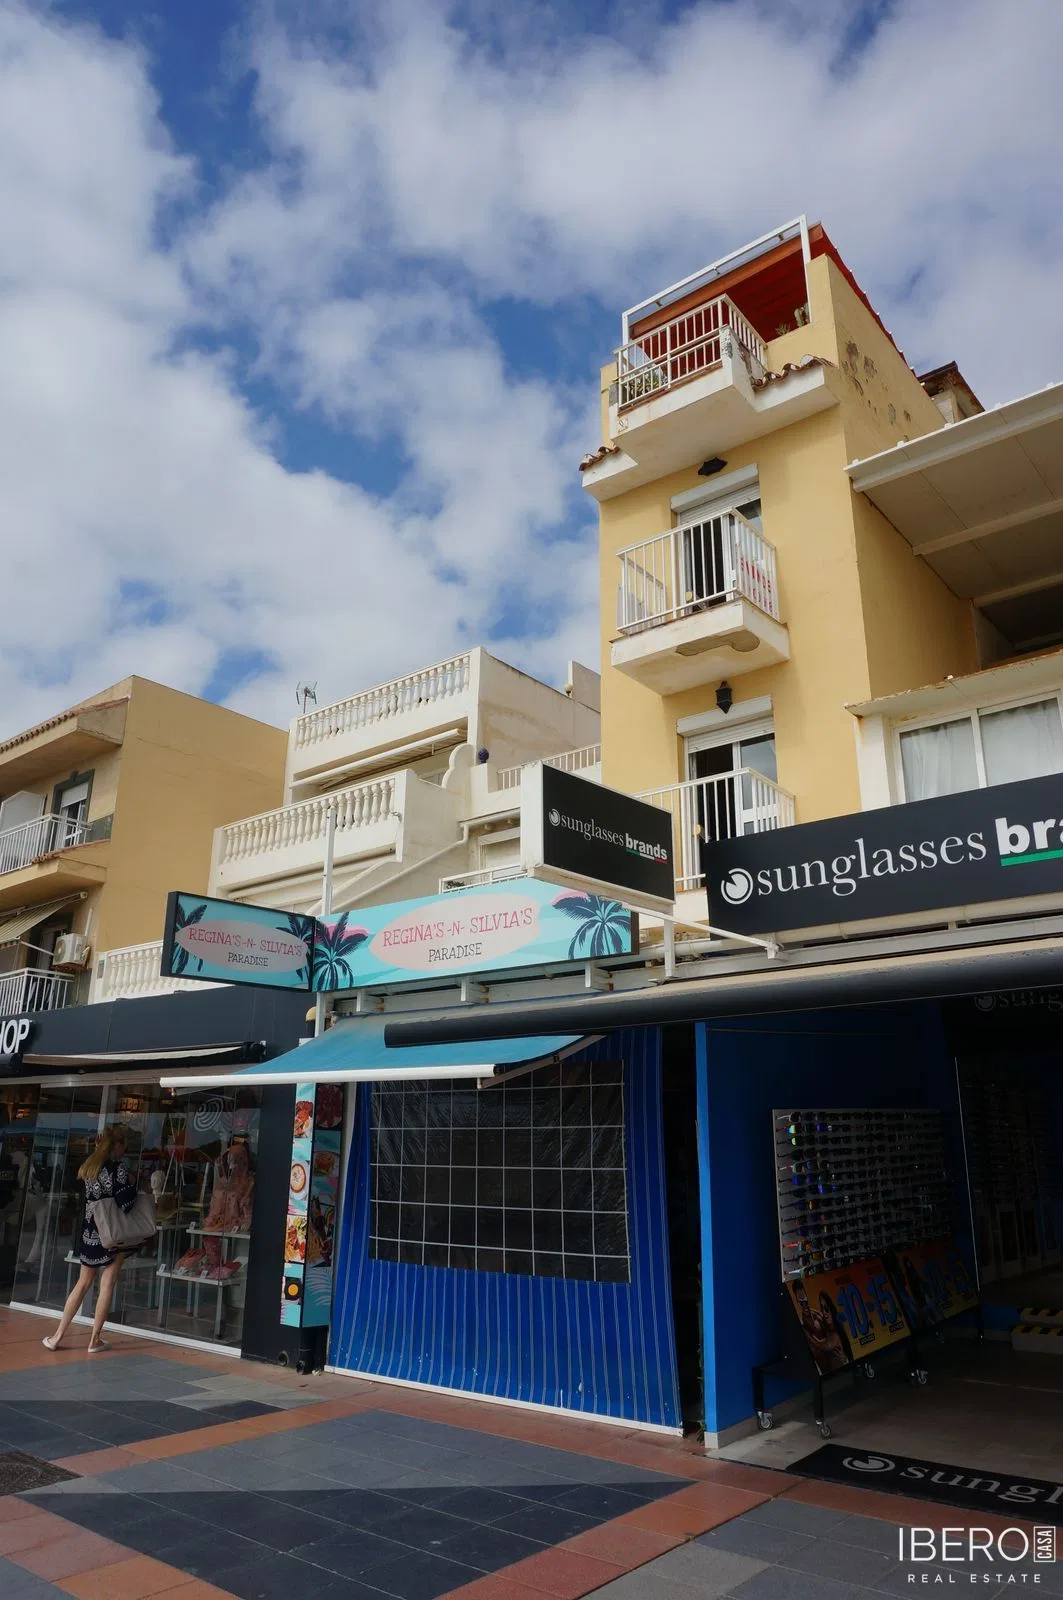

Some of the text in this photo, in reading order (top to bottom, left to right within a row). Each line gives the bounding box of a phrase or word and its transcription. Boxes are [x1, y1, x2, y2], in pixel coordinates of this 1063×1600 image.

[561, 814, 668, 860] sunglasses brands
[757, 817, 1063, 897] sunglasses br
[188, 927, 241, 948] REGINA'S
[259, 939, 303, 957] SILVIA'S
[383, 921, 445, 947] REGINA'S
[469, 907, 533, 934] SILVIA'S
[227, 952, 269, 967] PARADISE
[428, 942, 483, 963] PARADISE
